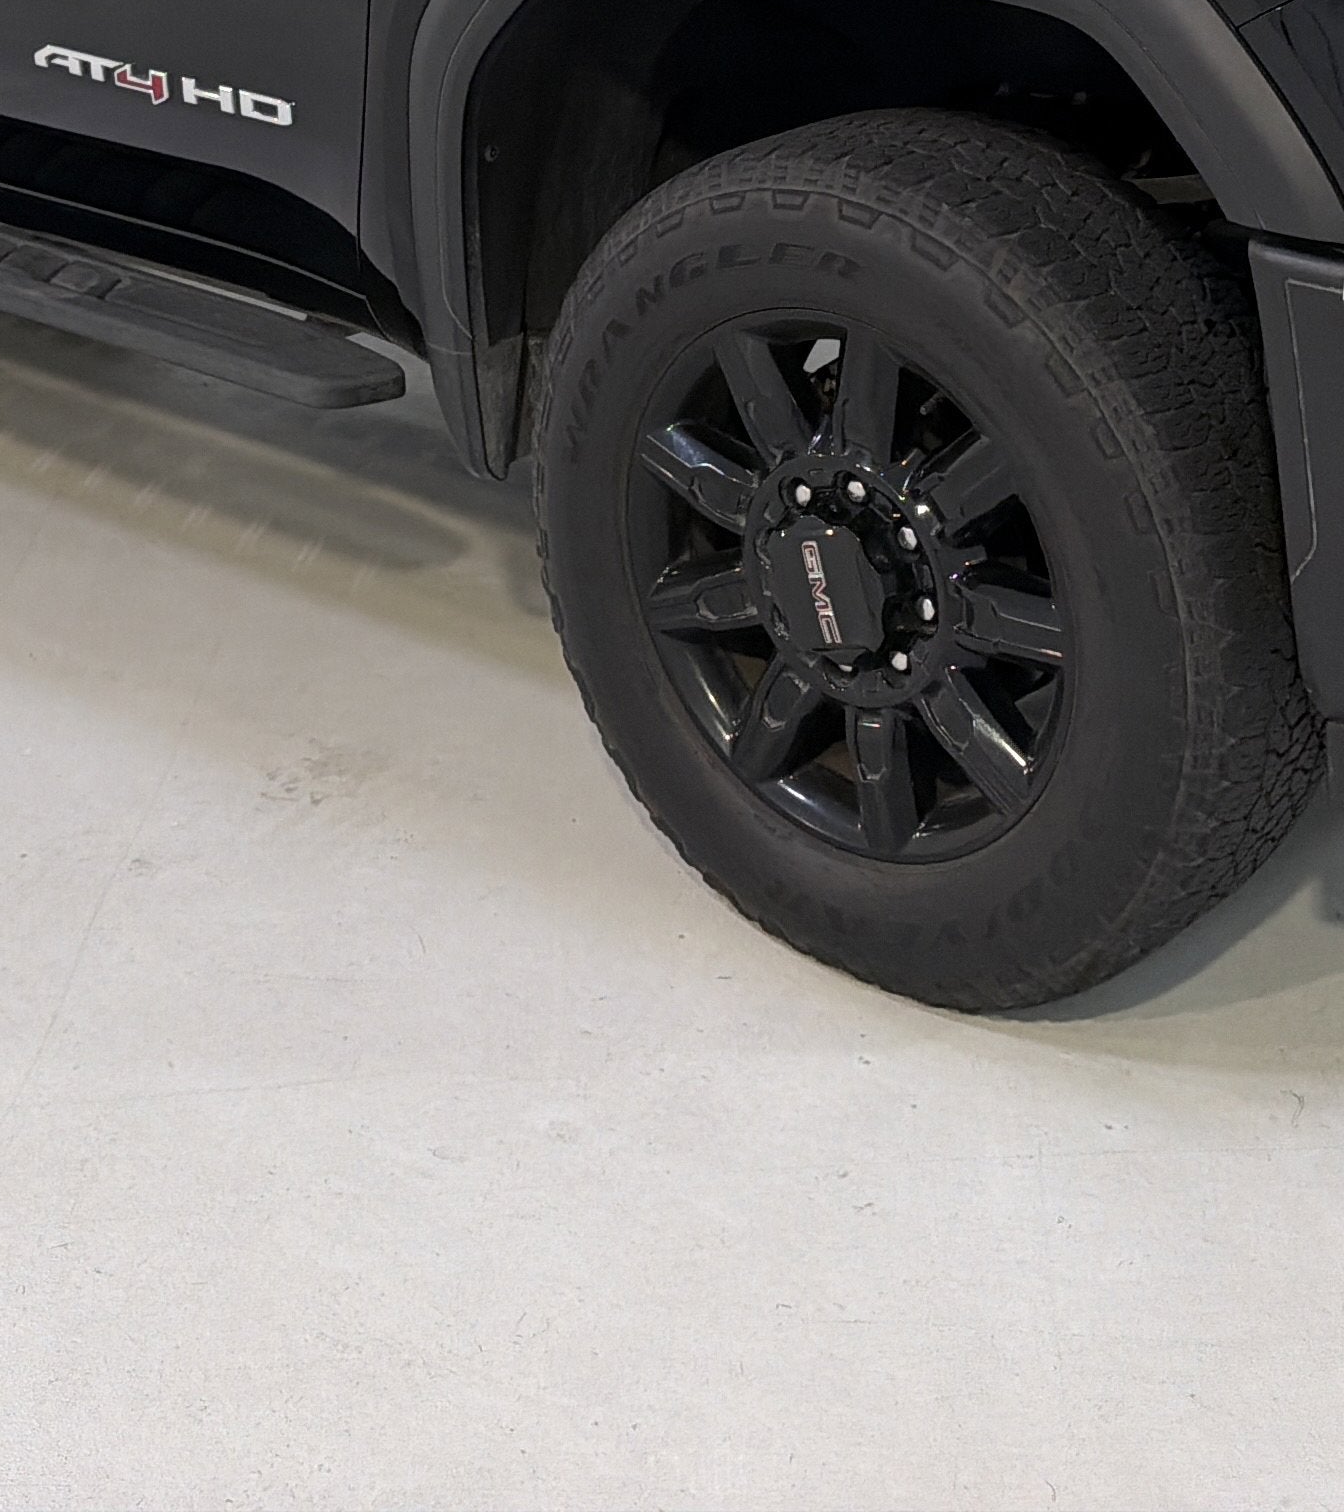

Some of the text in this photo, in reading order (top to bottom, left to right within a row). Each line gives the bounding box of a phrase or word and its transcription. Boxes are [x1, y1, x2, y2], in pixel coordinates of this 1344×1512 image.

[33, 44, 293, 126] AT4 HD
[801, 540, 843, 644] GMC
